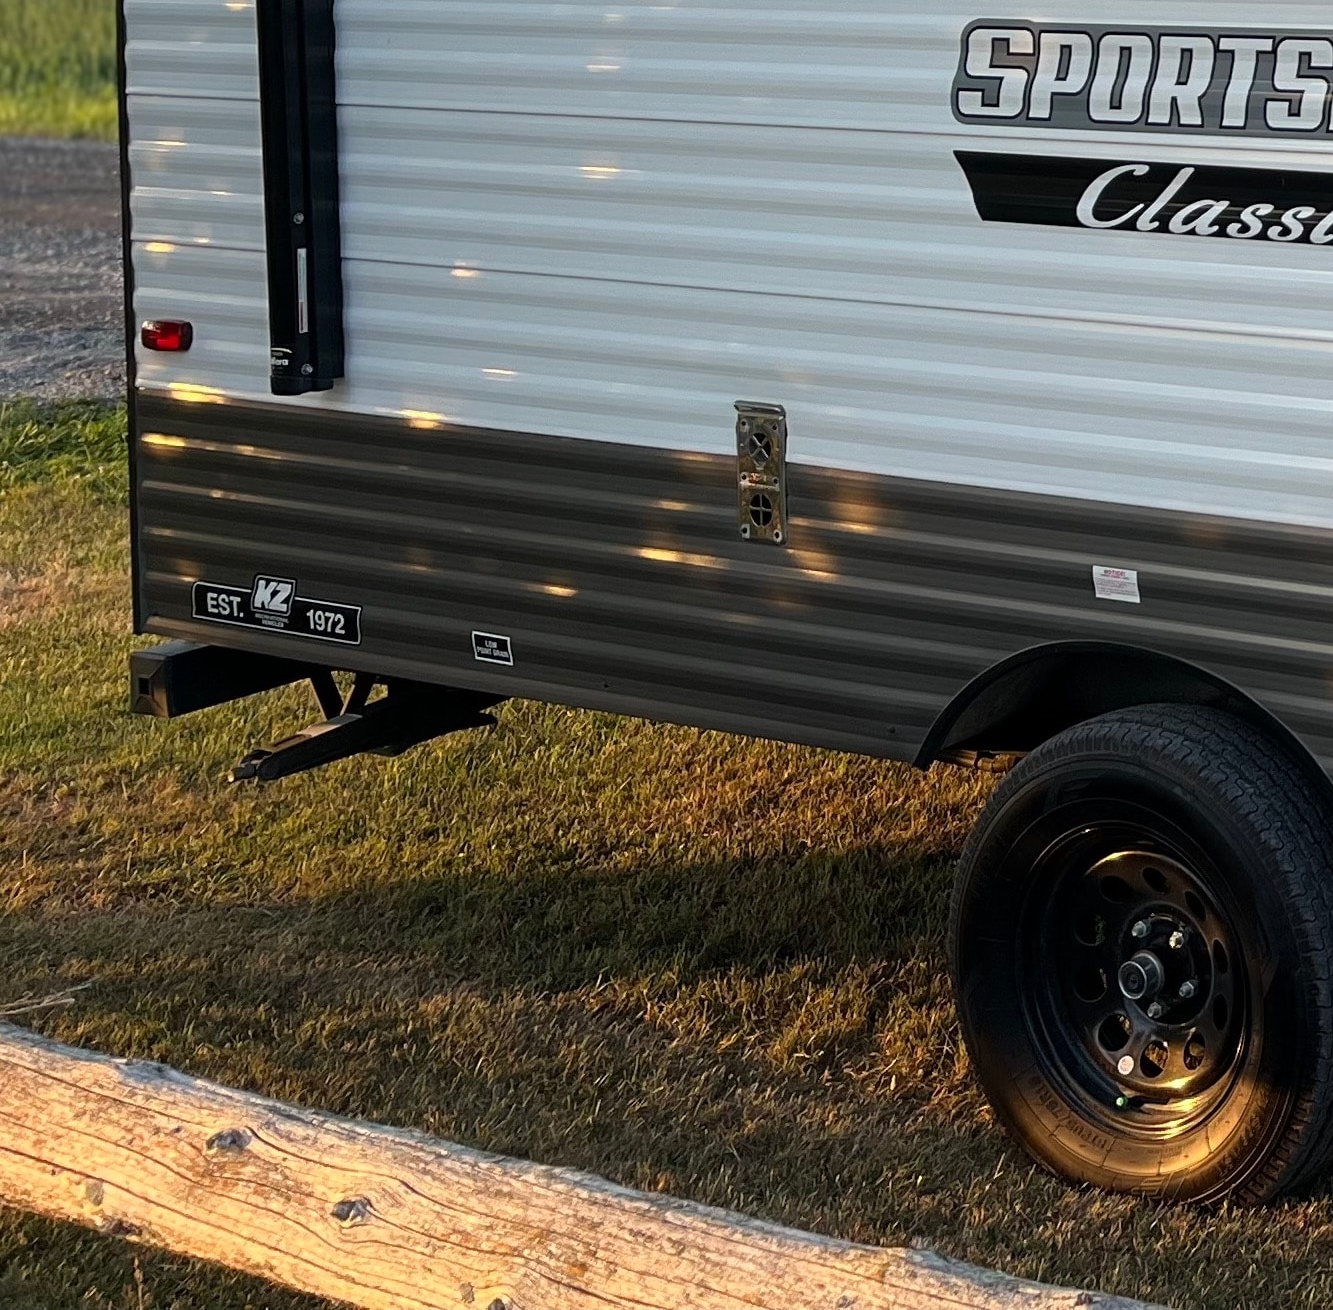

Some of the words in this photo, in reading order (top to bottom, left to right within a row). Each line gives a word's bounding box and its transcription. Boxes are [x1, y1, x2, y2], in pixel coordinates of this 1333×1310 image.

[206, 592, 244, 618] EST.
[254, 580, 292, 612] KZ
[306, 609, 346, 635] 1972
